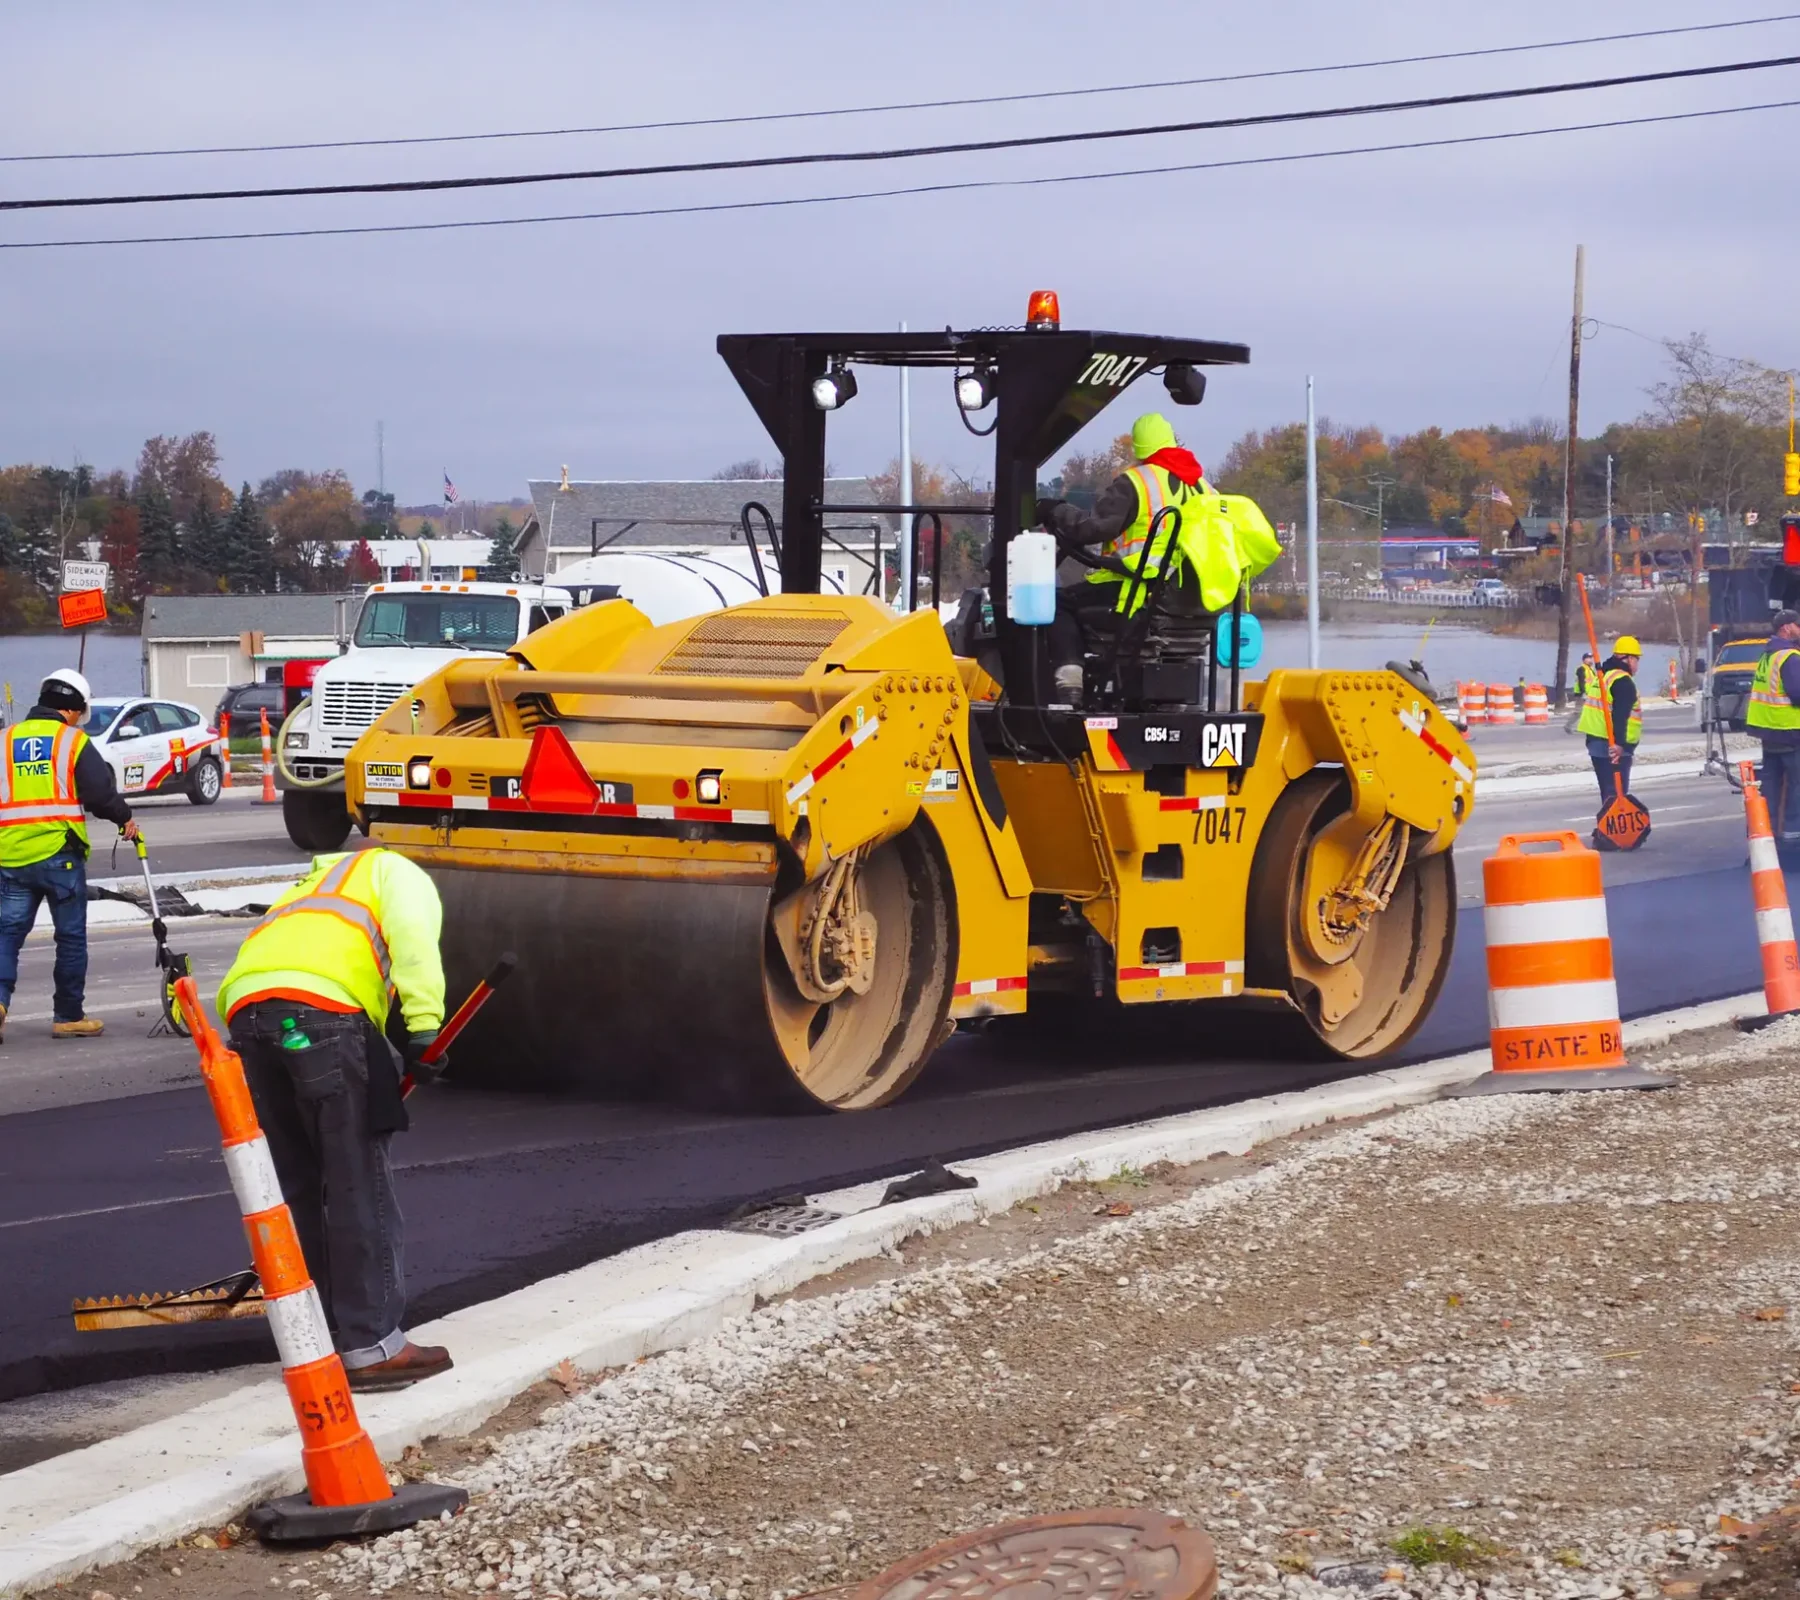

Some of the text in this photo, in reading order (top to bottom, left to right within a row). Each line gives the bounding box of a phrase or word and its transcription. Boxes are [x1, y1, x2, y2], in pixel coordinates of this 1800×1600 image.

[1077, 353, 1148, 386] 7047
[66, 566, 105, 576] SIDEWALK
[70, 578, 100, 588] CLOSED
[1144, 727, 1168, 743] CB54
[1201, 723, 1247, 768] CAT
[15, 763, 50, 777] TYME
[367, 764, 403, 776] CAUTION
[1191, 807, 1246, 845] 7047
[1605, 811, 1645, 836] SLOW
[1505, 1035, 1589, 1062] STATE
